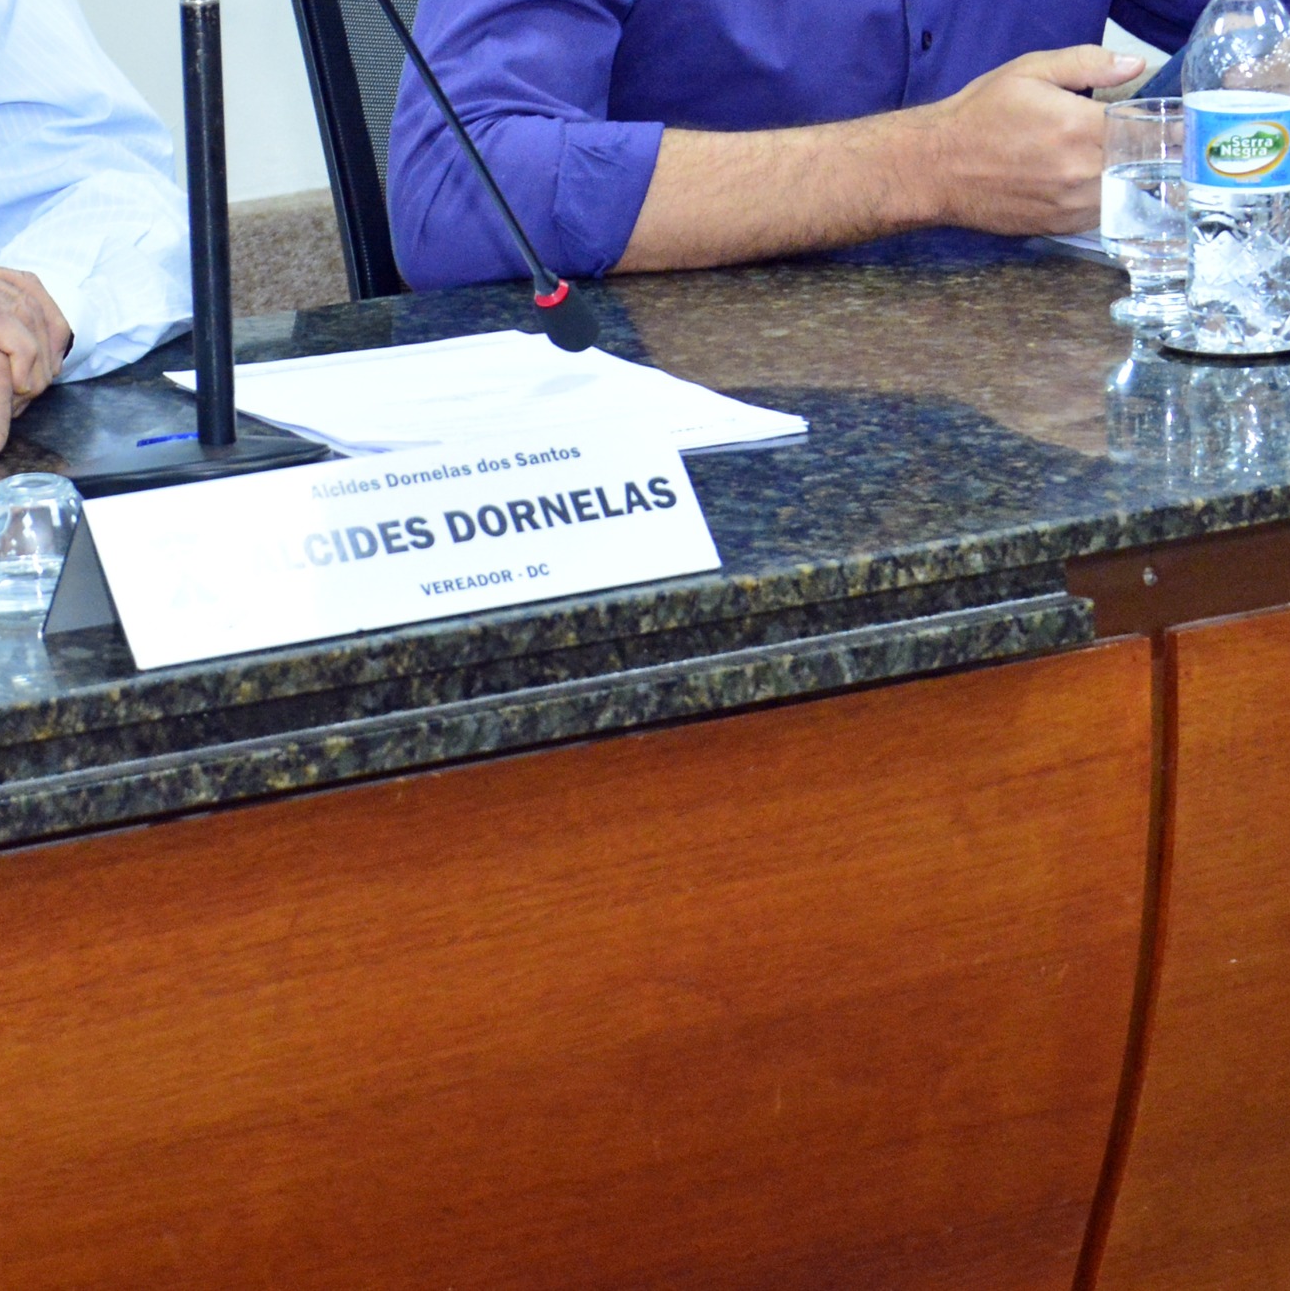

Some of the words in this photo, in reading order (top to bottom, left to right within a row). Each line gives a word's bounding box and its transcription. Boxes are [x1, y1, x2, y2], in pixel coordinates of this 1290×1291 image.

[1220, 144, 1268, 159] Negra
[1231, 135, 1273, 148] Serra
[311, 475, 381, 500] Alcides
[385, 464, 472, 488] Dornelas
[477, 457, 511, 474] dos
[515, 446, 581, 468] Santos
[444, 476, 677, 543] DORNELAS
[420, 569, 513, 597] VEREADOR
[526, 563, 550, 579] DC
